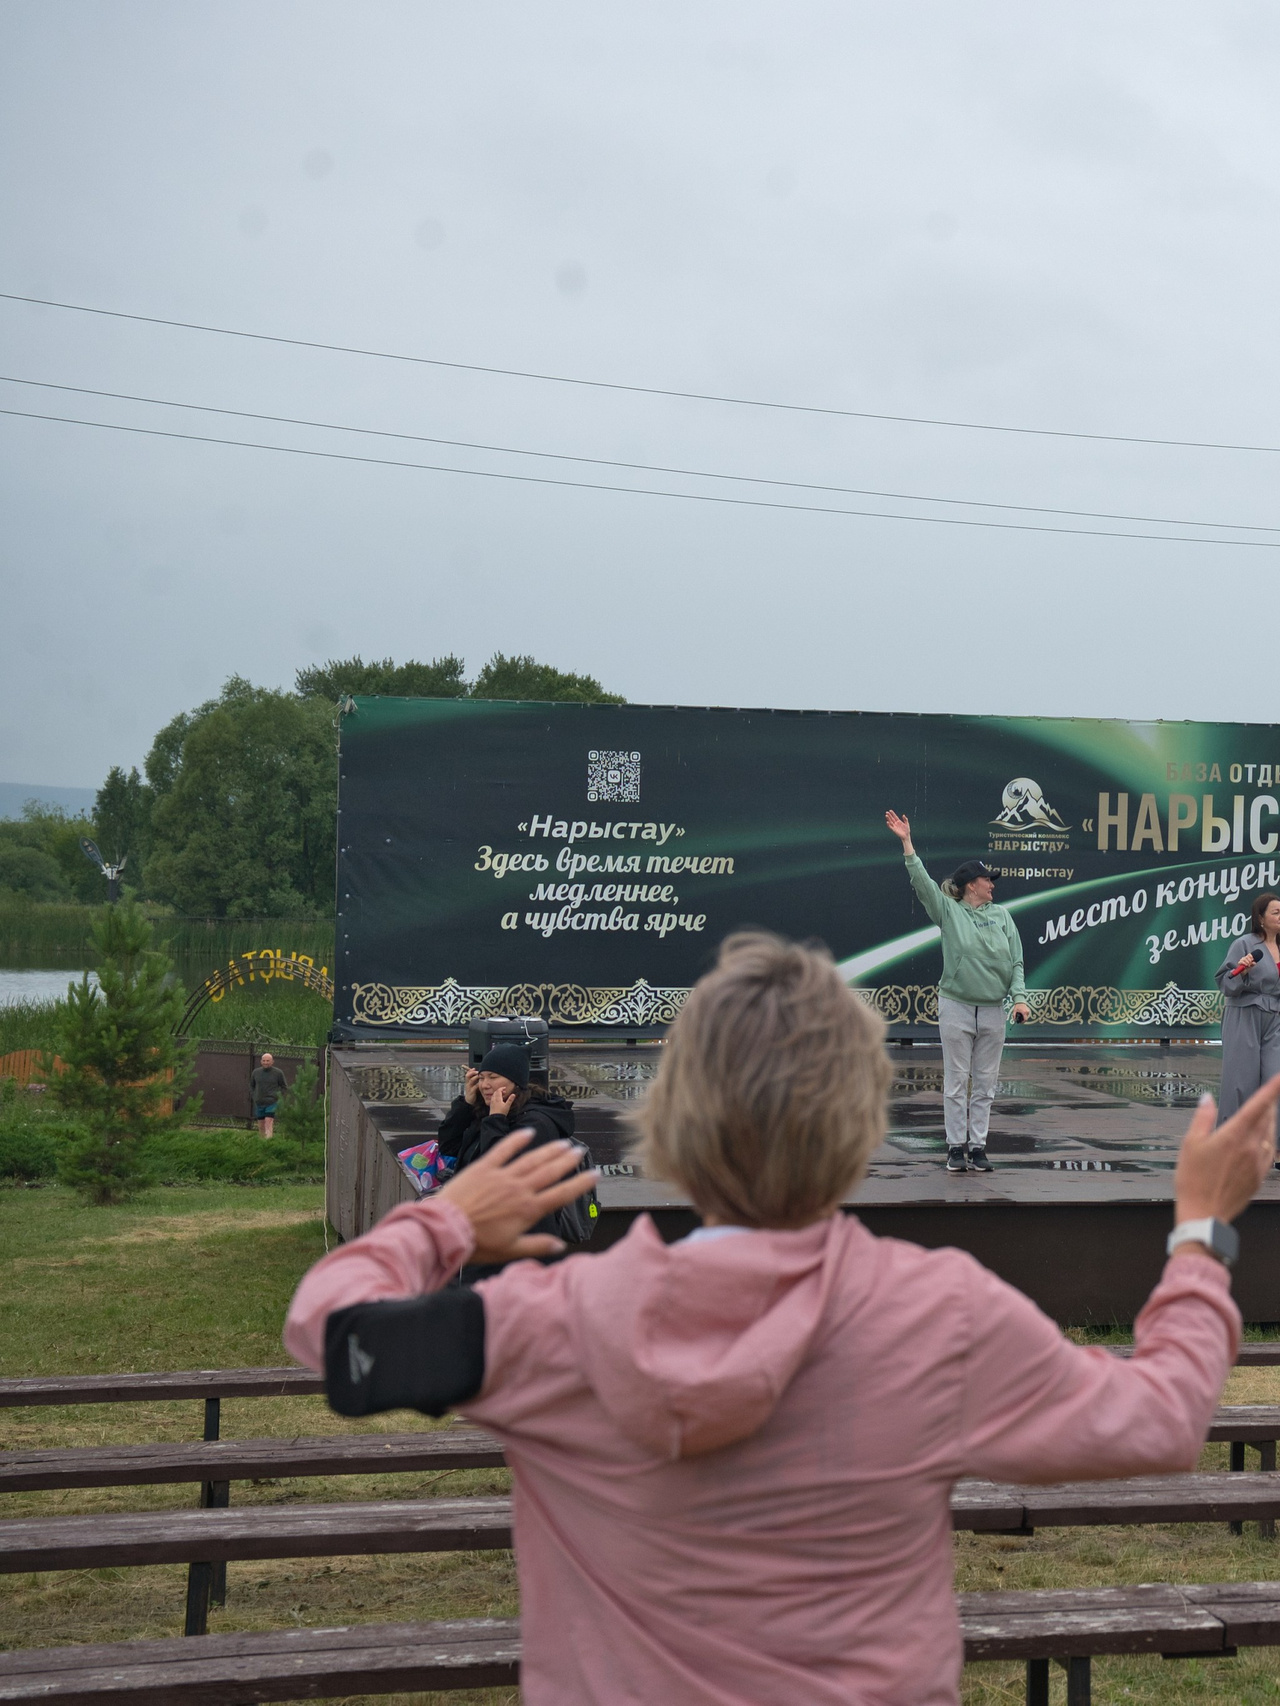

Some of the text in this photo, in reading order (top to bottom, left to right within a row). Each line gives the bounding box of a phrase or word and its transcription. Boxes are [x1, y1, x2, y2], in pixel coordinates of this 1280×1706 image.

[1166, 762, 1222, 783] БАЗА
[517, 815, 686, 846] «Нарыстау»
[988, 832, 1038, 840] Туристический
[988, 840, 1070, 852] «НАРЫСТАУ»
[474, 845, 735, 879] Здесь время течет
[529, 881, 680, 908] медленнее,
[501, 905, 707, 938] а чувства ярче
[1037, 888, 1147, 945] место
[1145, 909, 1252, 965] земно
